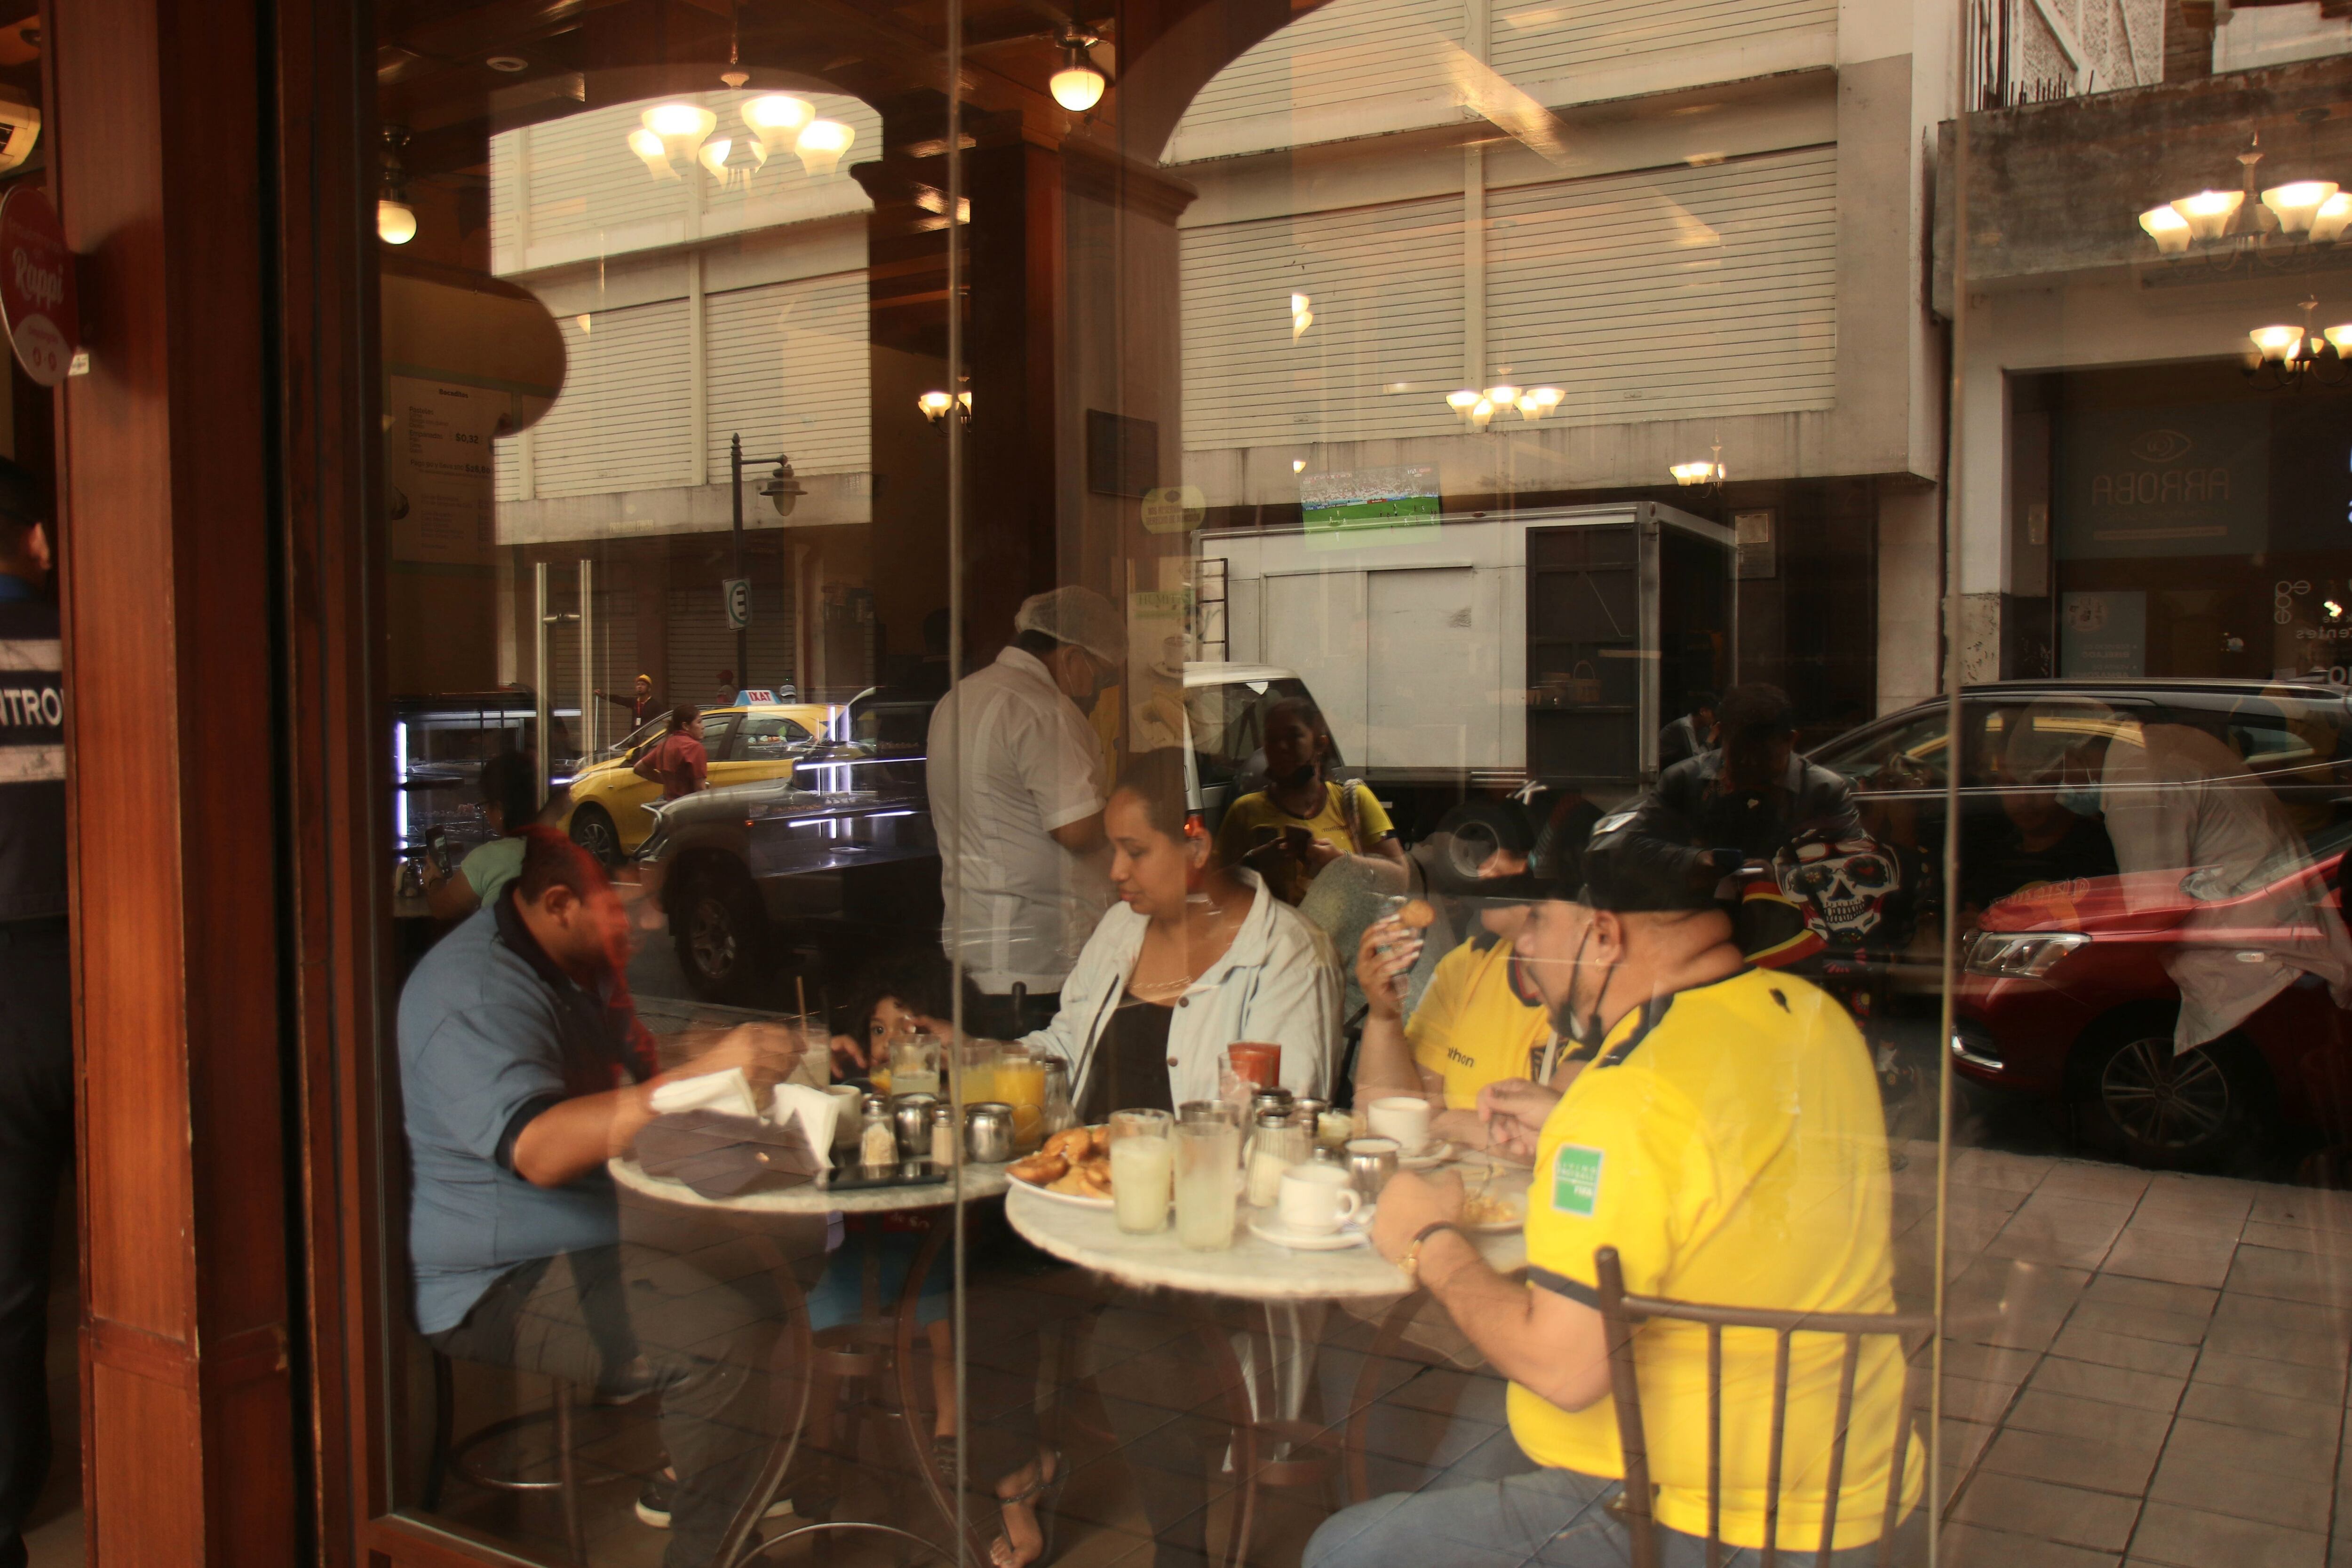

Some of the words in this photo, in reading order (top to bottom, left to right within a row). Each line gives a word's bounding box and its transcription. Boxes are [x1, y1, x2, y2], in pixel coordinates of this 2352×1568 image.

[12, 247, 64, 310] Rappi
[439, 388, 469, 398] Bocaditos
[409, 406, 434, 415] Pasteles
[409, 429, 443, 439] Empanadas
[455, 432, 479, 444] $0,32
[465, 463, 491, 474] $28,80
[1574, 1184, 1593, 1198] FIFA
